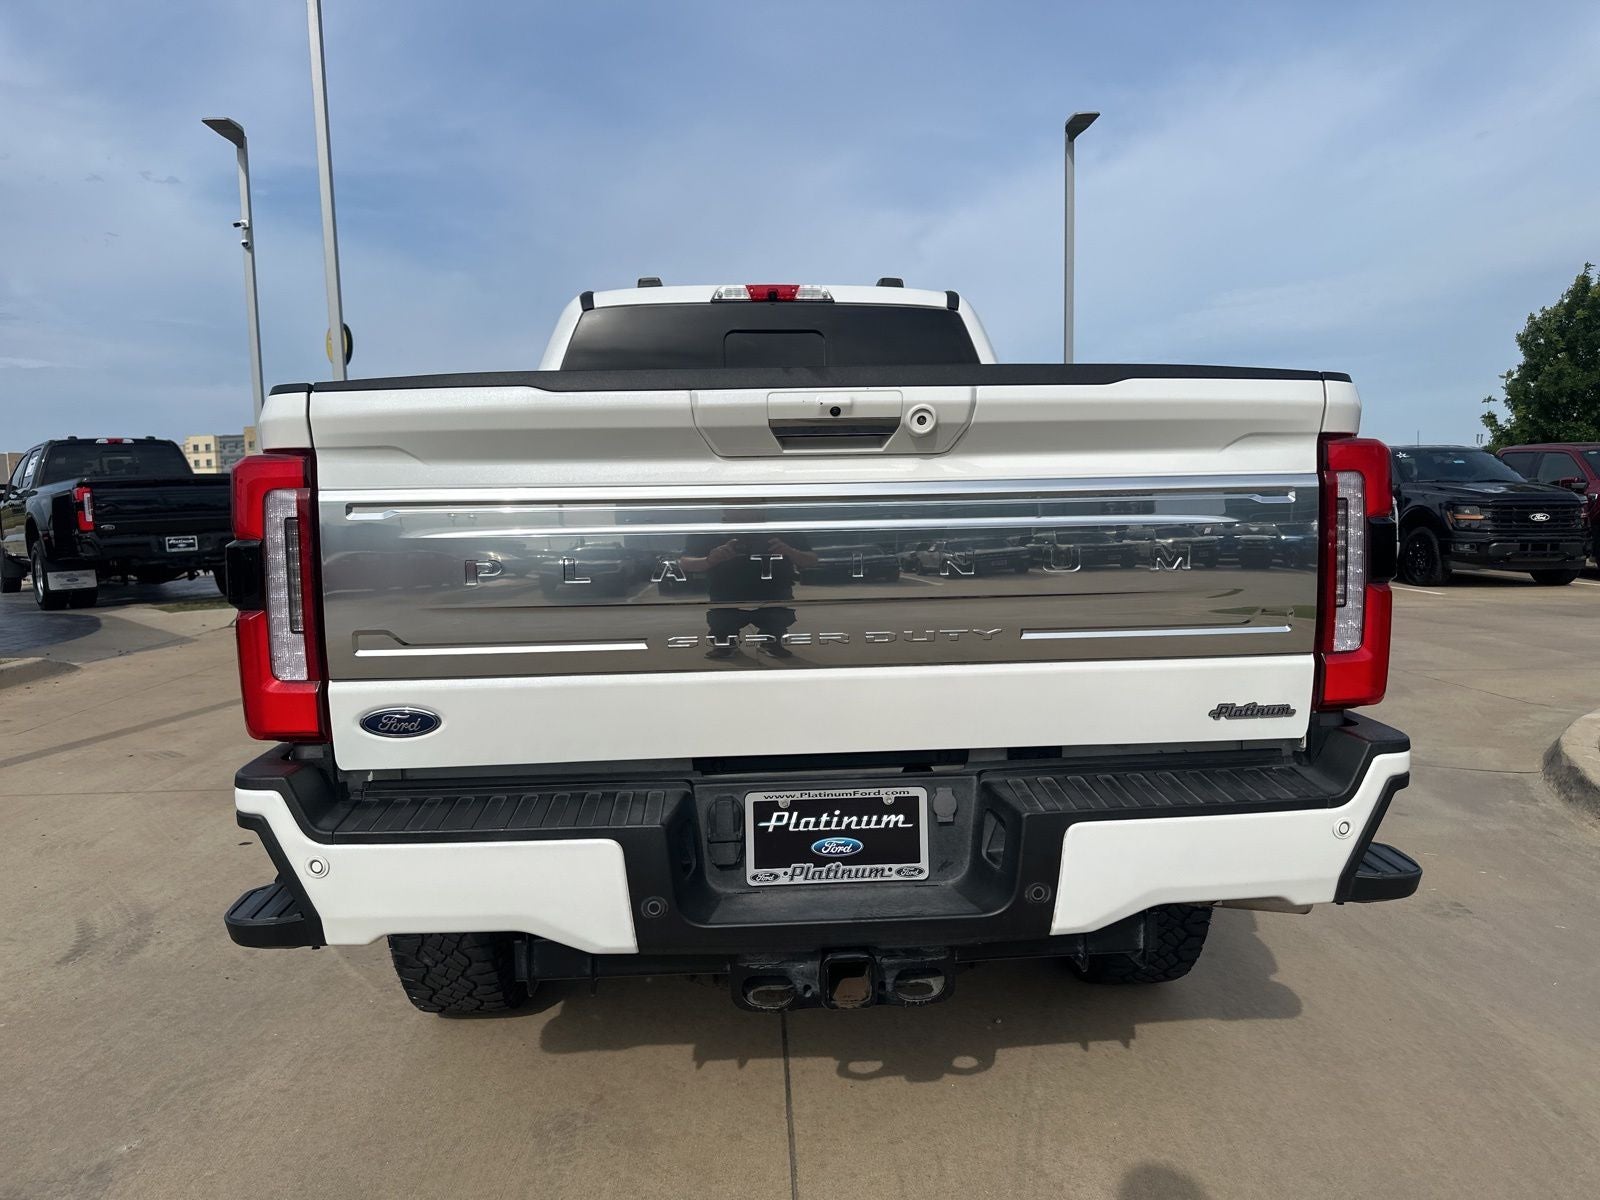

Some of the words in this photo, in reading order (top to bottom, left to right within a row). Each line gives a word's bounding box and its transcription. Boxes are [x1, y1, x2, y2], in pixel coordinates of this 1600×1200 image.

[464, 544, 1192, 586] PLATINUM
[667, 631, 850, 648] SUPER
[865, 628, 1002, 643] DUTY
[1208, 702, 1296, 720] Platinum
[763, 789, 910, 800] www.PlatinumFord.com
[757, 809, 914, 832] Platinum
[821, 839, 853, 854] Ford
[788, 862, 893, 882] Platinum
